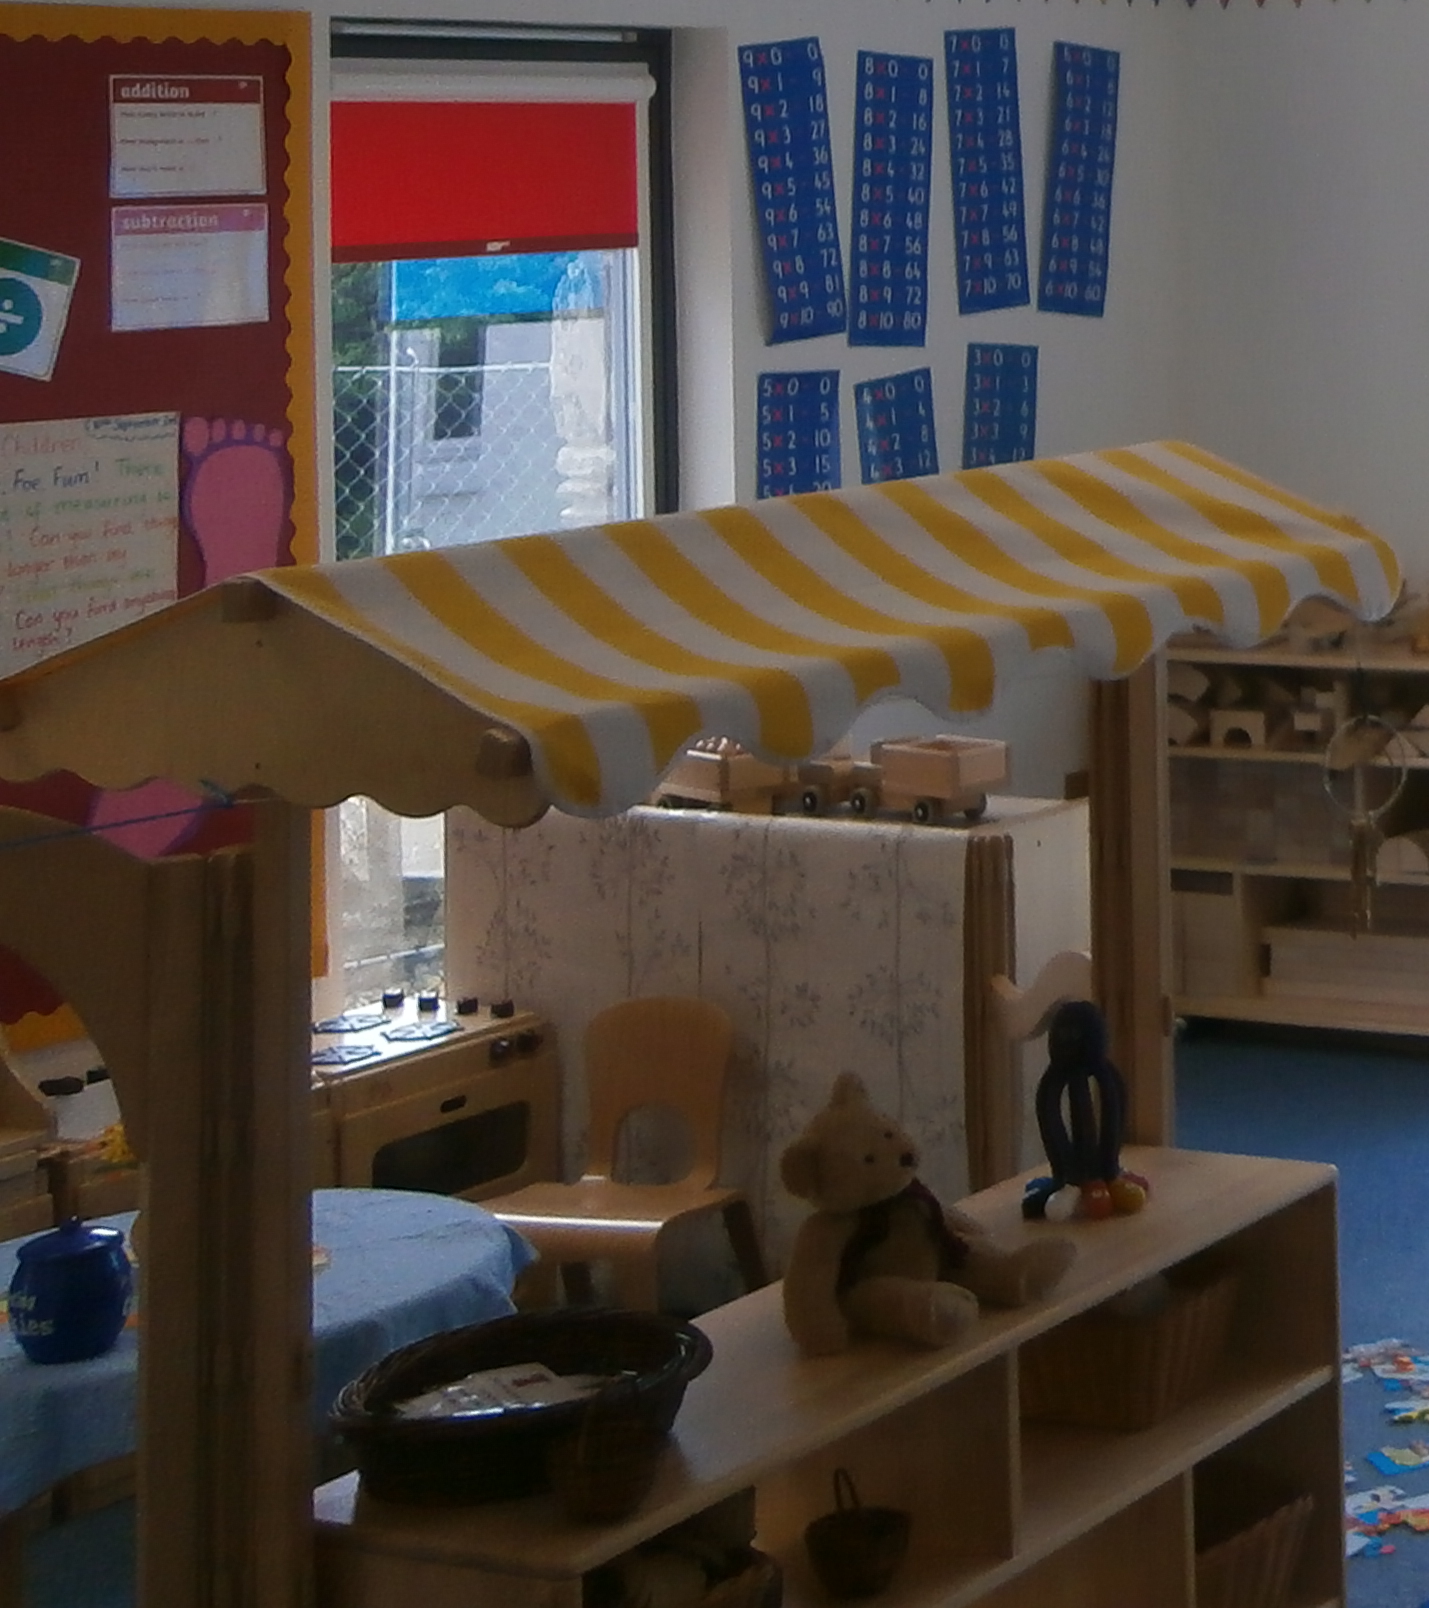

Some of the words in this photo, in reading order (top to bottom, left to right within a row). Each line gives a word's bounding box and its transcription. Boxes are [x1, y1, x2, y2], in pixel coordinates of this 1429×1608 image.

[806, 42, 819, 62] 0
[812, 67, 822, 87] 9
[918, 62, 929, 81] 0
[121, 82, 189, 99] addition
[918, 88, 928, 107] 8
[809, 93, 824, 113] 18
[810, 119, 825, 141] 27
[912, 112, 927, 131] 16
[813, 145, 829, 166] 36
[910, 136, 926, 156] 24
[814, 170, 831, 190] 45
[910, 161, 925, 181] 32
[907, 187, 925, 205] 40
[815, 197, 832, 216] 54
[123, 211, 220, 230] subtraction
[905, 211, 923, 231] 48
[817, 221, 835, 242] 63
[905, 235, 922, 255] 56
[820, 247, 838, 268] 72
[904, 261, 921, 280] 64
[825, 274, 840, 294] 81
[906, 285, 922, 305] 72
[826, 297, 843, 318] 90
[903, 310, 922, 330] 80
[819, 376, 831, 395] 0
[913, 374, 925, 393] 0
[820, 402, 830, 422] 5
[918, 400, 926, 417] 4
[814, 428, 832, 448] 10
[920, 424, 929, 443] 8
[815, 454, 831, 474] 15
[918, 448, 932, 470] 12
